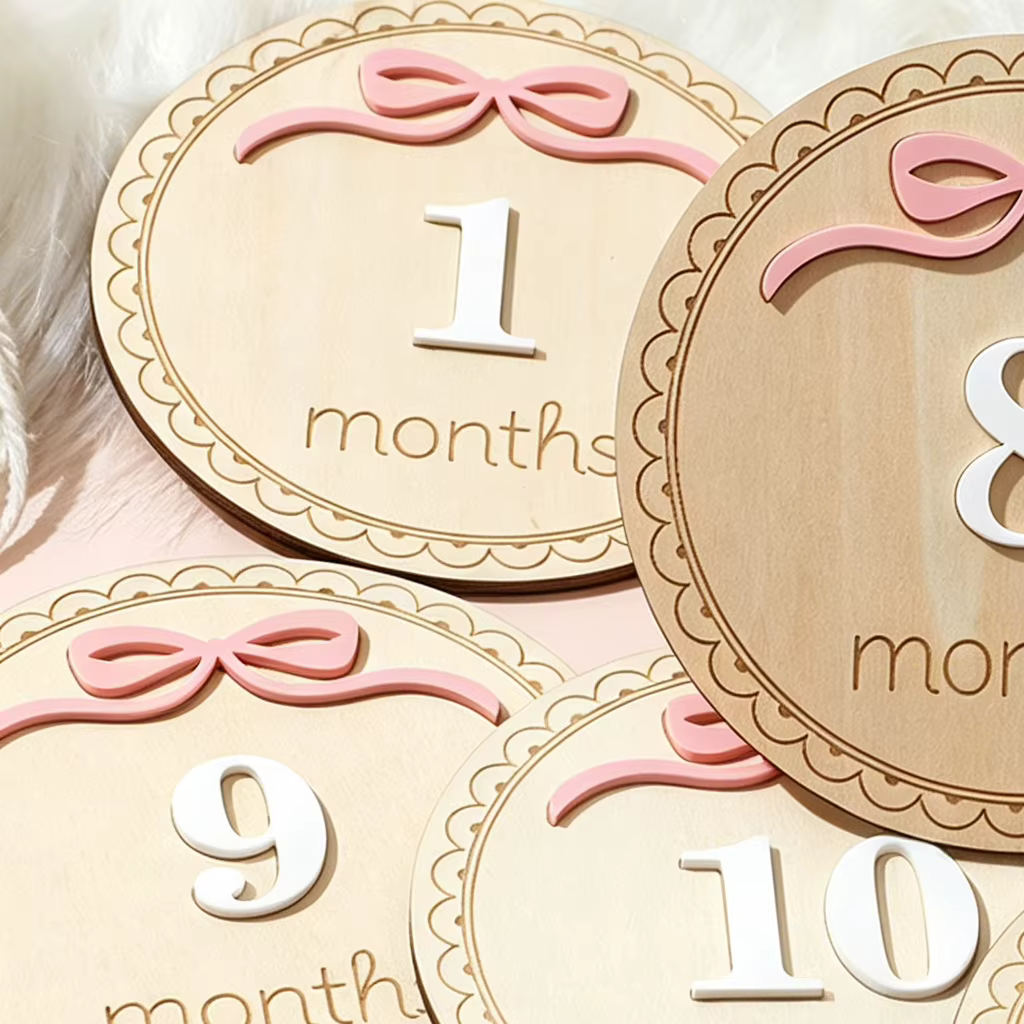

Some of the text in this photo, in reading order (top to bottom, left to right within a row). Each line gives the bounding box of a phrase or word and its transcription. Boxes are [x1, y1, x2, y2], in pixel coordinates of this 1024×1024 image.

[412, 197, 537, 355] 1
[305, 400, 617, 477] months
[170, 754, 329, 921] 9
[678, 835, 980, 1001] 10
